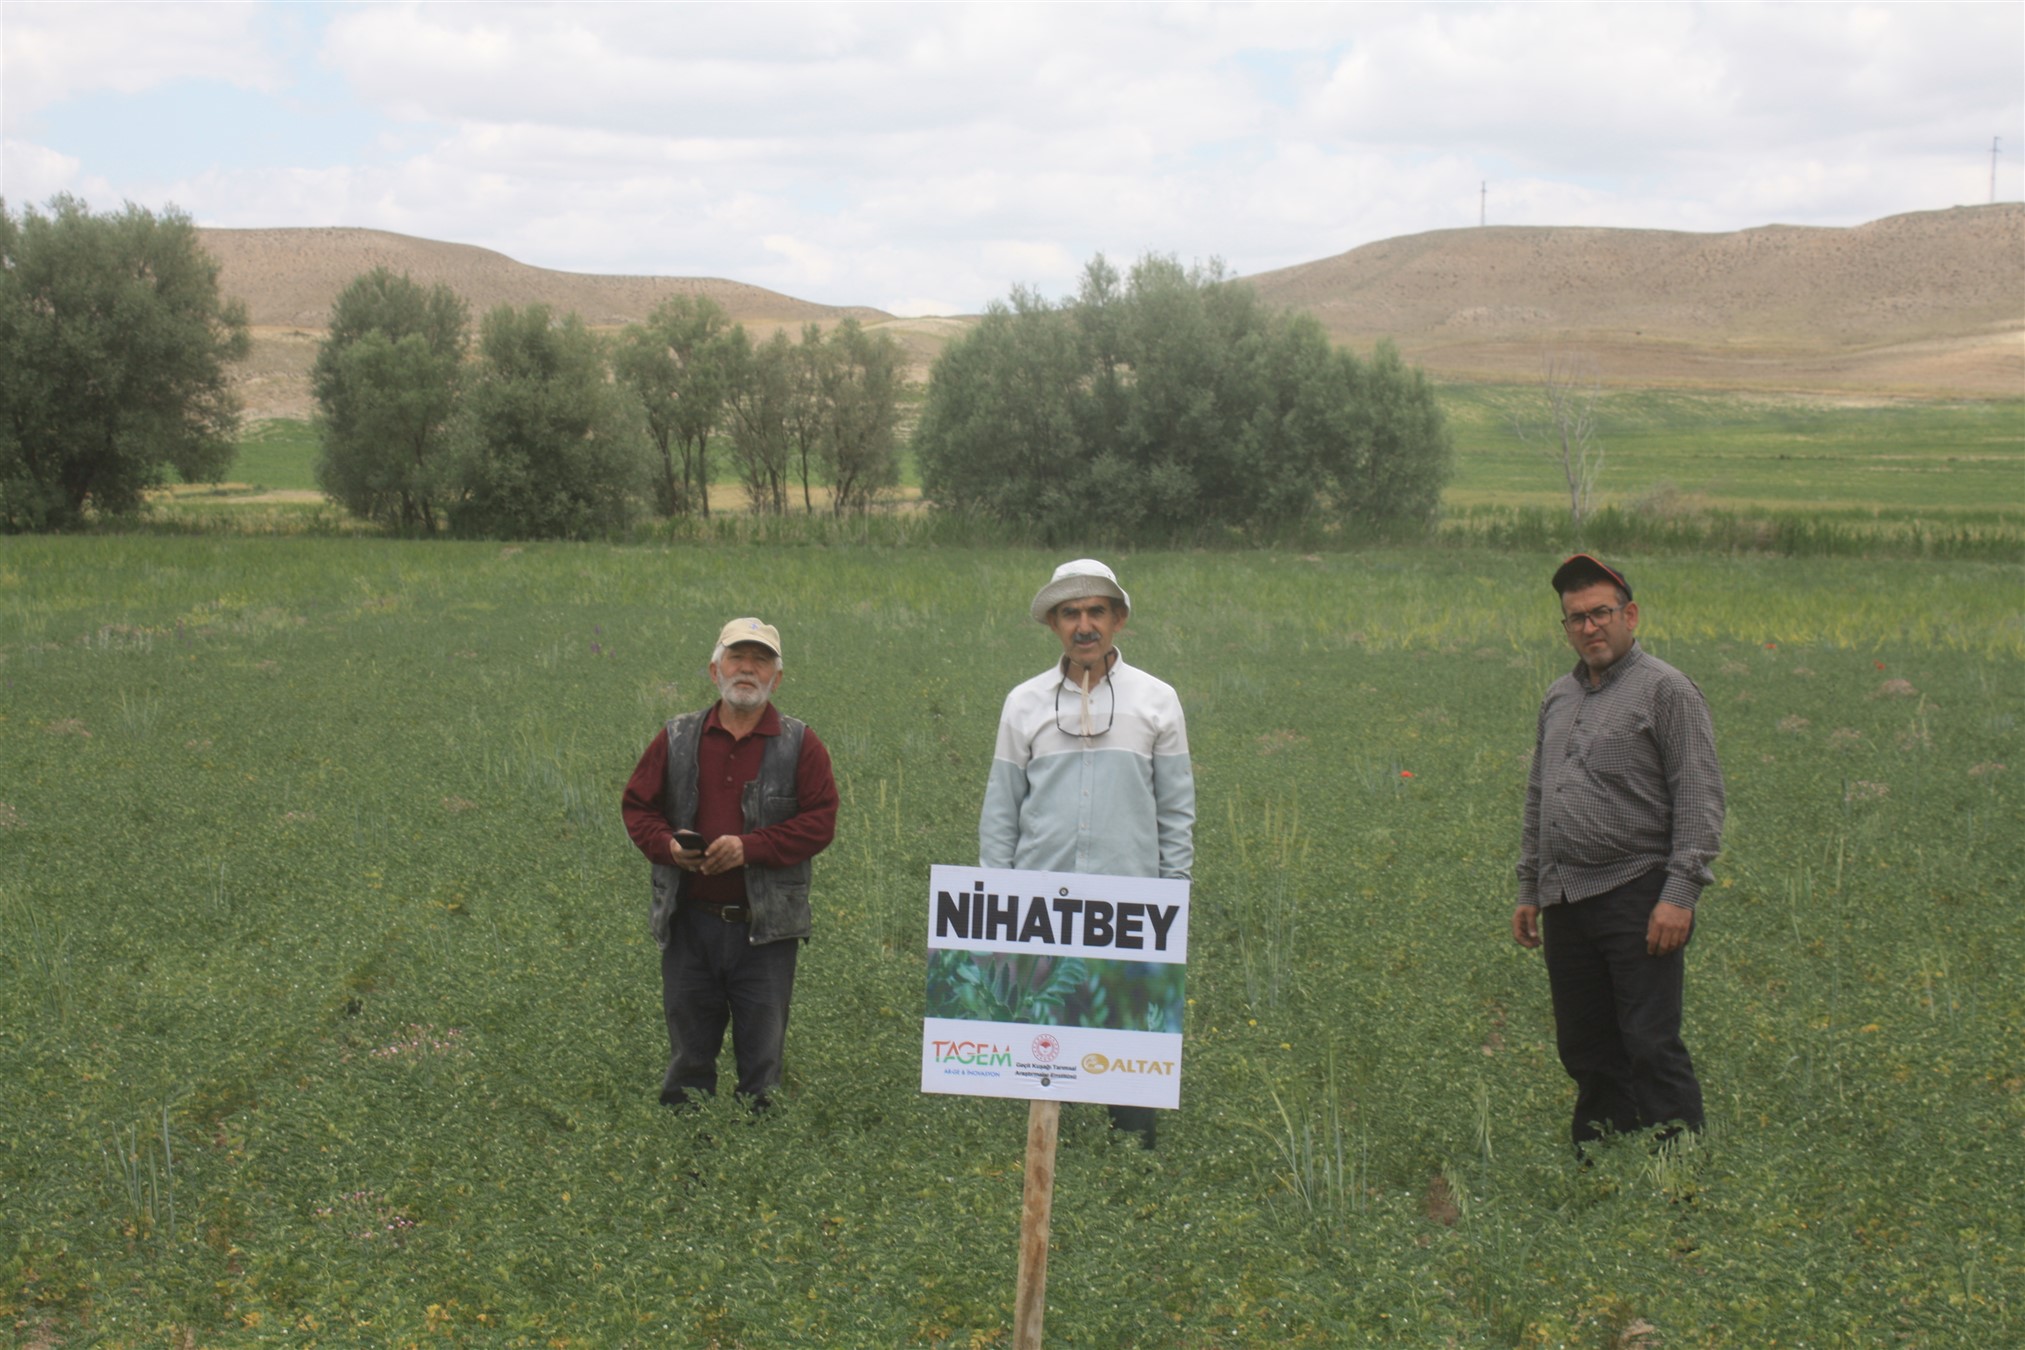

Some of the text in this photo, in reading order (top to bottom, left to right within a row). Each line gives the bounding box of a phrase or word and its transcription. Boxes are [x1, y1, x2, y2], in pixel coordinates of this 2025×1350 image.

[936, 881, 1180, 951] NİHATBEY
[931, 1041, 1012, 1067] TAGEM
[1110, 1058, 1175, 1076] ALTAT
